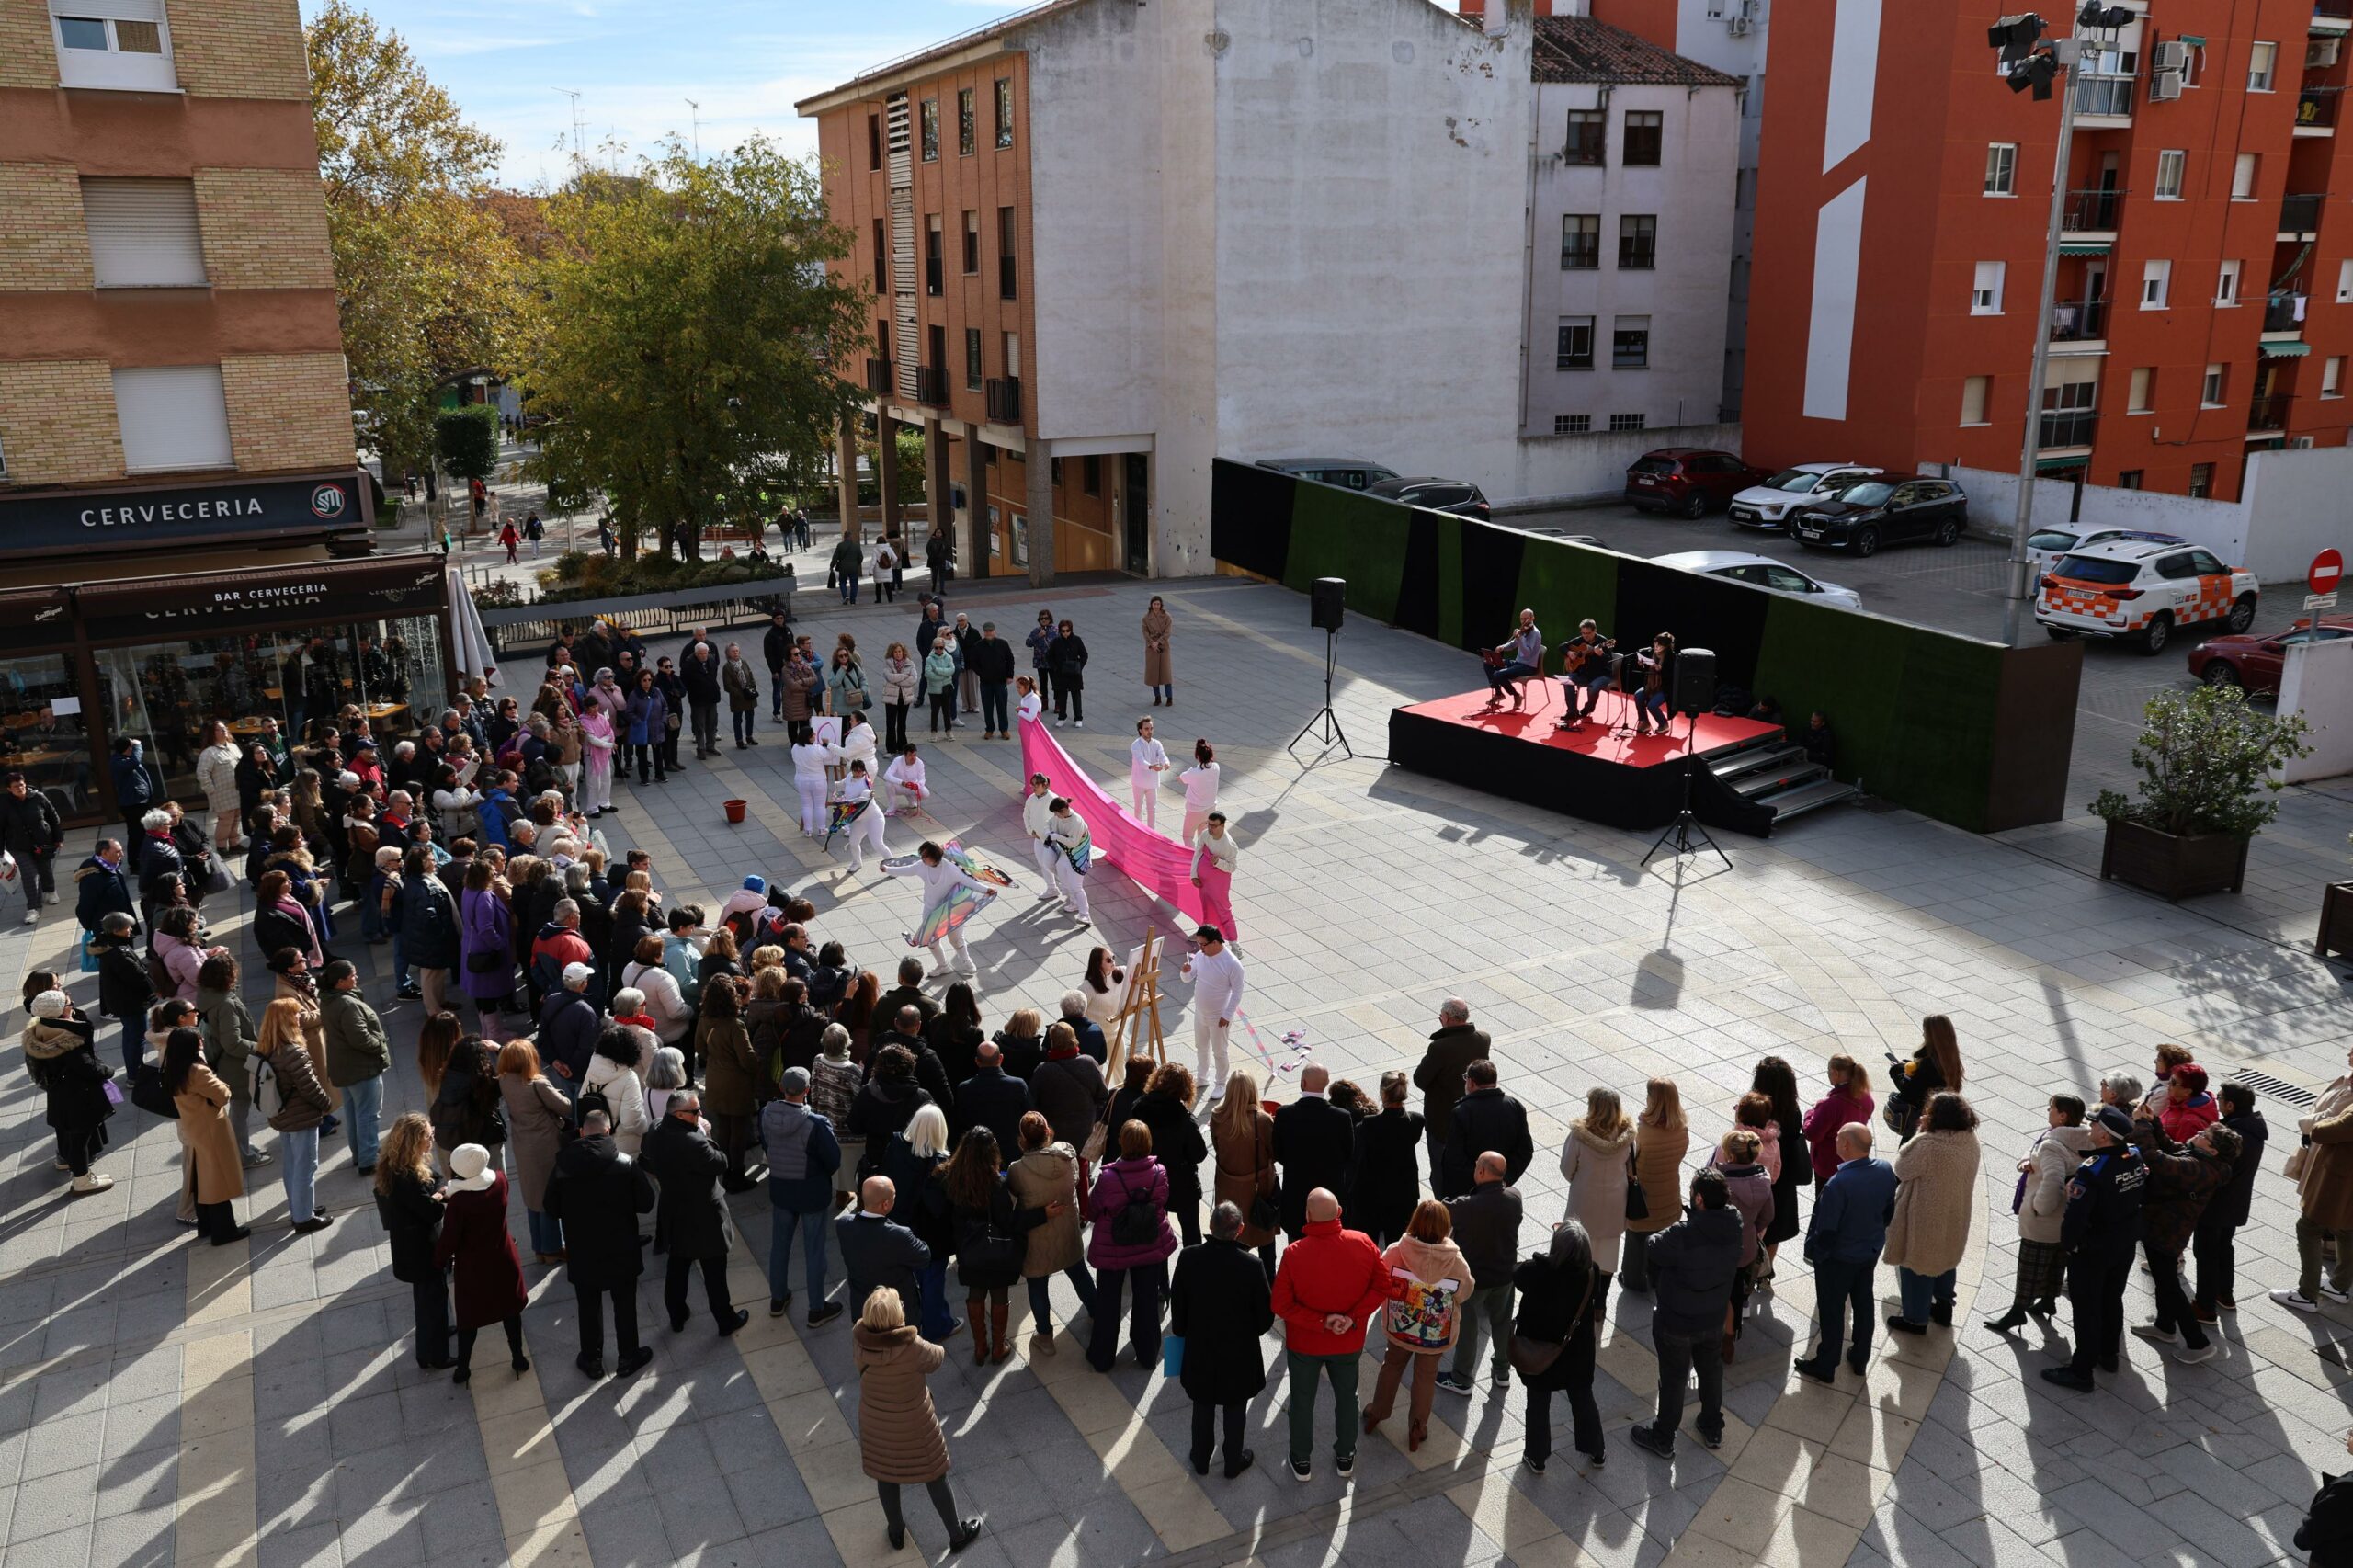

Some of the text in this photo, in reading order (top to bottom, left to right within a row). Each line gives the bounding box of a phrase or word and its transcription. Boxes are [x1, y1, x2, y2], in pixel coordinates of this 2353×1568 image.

[81, 497, 263, 527] CERVECERIA
[214, 584, 327, 602] BAR CERVECERIA
[2115, 1165, 2143, 1184] POLIC
